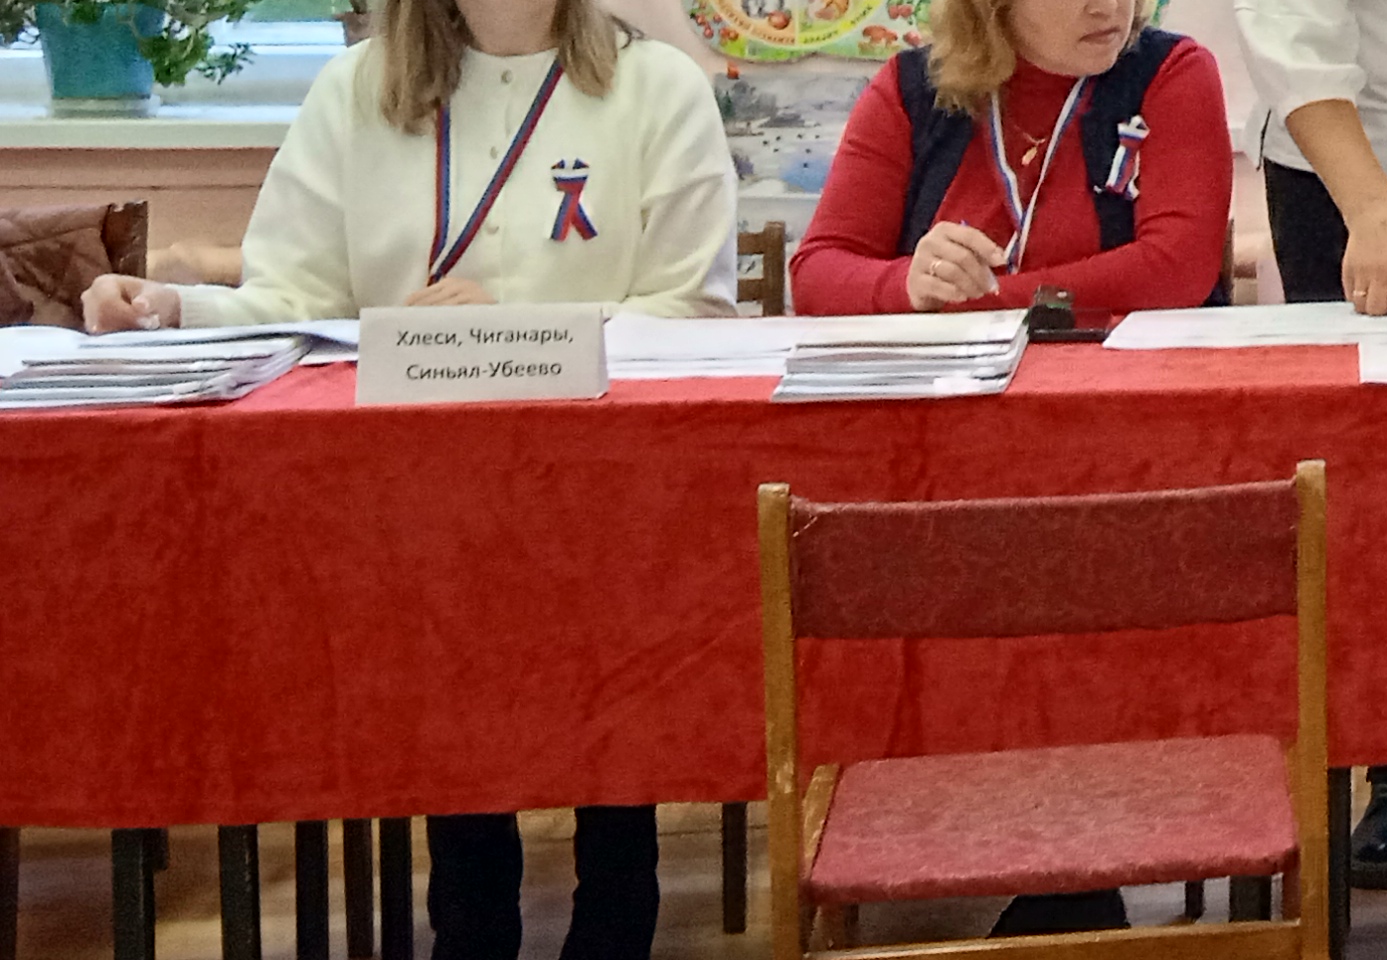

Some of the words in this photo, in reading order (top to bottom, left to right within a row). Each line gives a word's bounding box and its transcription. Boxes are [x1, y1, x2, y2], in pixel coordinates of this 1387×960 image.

[396, 329, 463, 348] Хлеси,
[469, 327, 574, 345] Чиганары,
[406, 359, 562, 380] Синьял-Убеево
